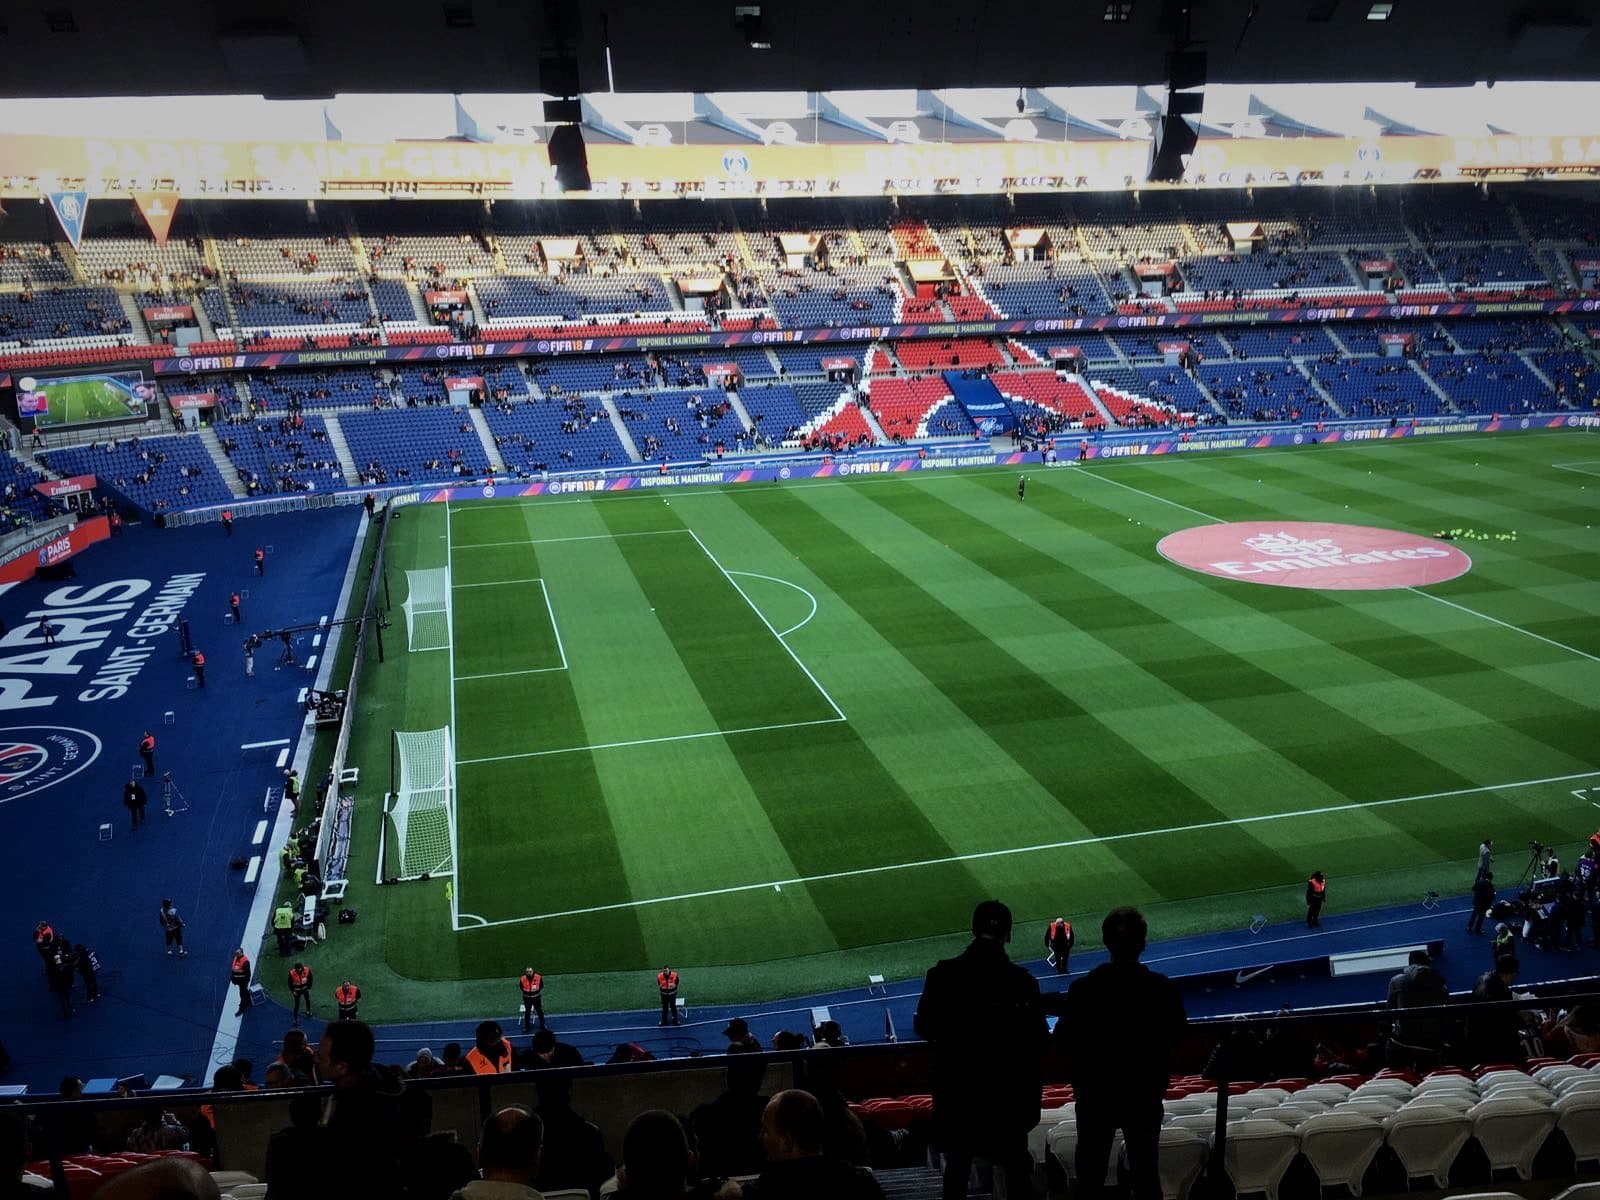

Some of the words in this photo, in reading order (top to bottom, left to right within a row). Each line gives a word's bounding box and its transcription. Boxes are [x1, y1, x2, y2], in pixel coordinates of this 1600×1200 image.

[636, 336, 671, 347] DISPONIBLE
[673, 335, 711, 346] MAINTENANT
[298, 352, 340, 362] DISPONIBLE
[342, 350, 387, 361] MAINTENANT
[641, 475, 679, 487] DISPONIBLE
[681, 473, 724, 484] MAINTENANT
[47, 537, 71, 557] PARIS
[1210, 546, 1451, 575] Emirates
